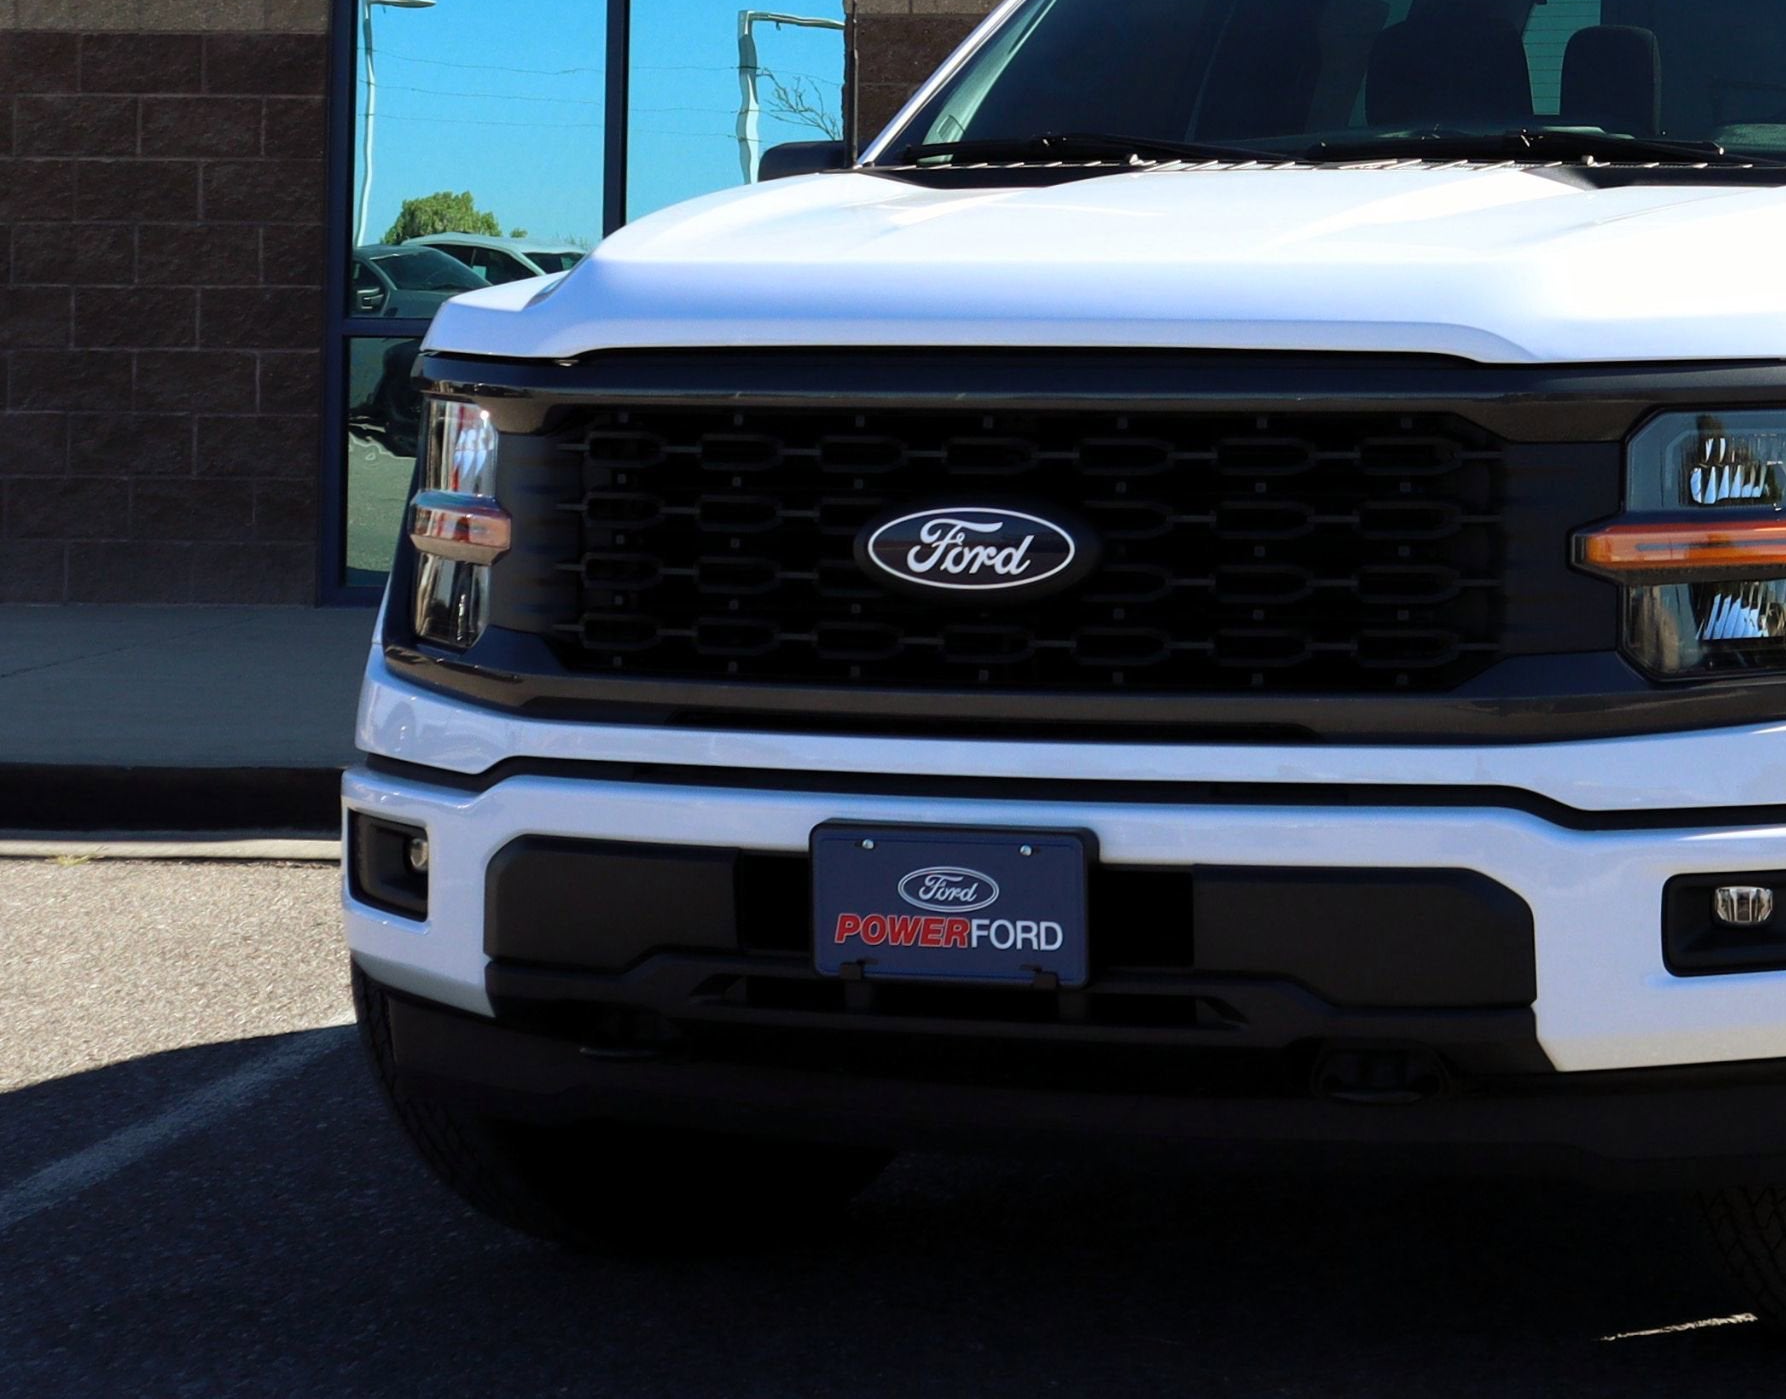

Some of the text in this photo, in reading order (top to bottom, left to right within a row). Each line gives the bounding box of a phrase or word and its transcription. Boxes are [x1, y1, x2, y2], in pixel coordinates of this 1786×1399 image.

[906, 518, 1035, 576] Ford
[918, 873, 979, 904] Ford
[834, 913, 1063, 951] POWERFORD
